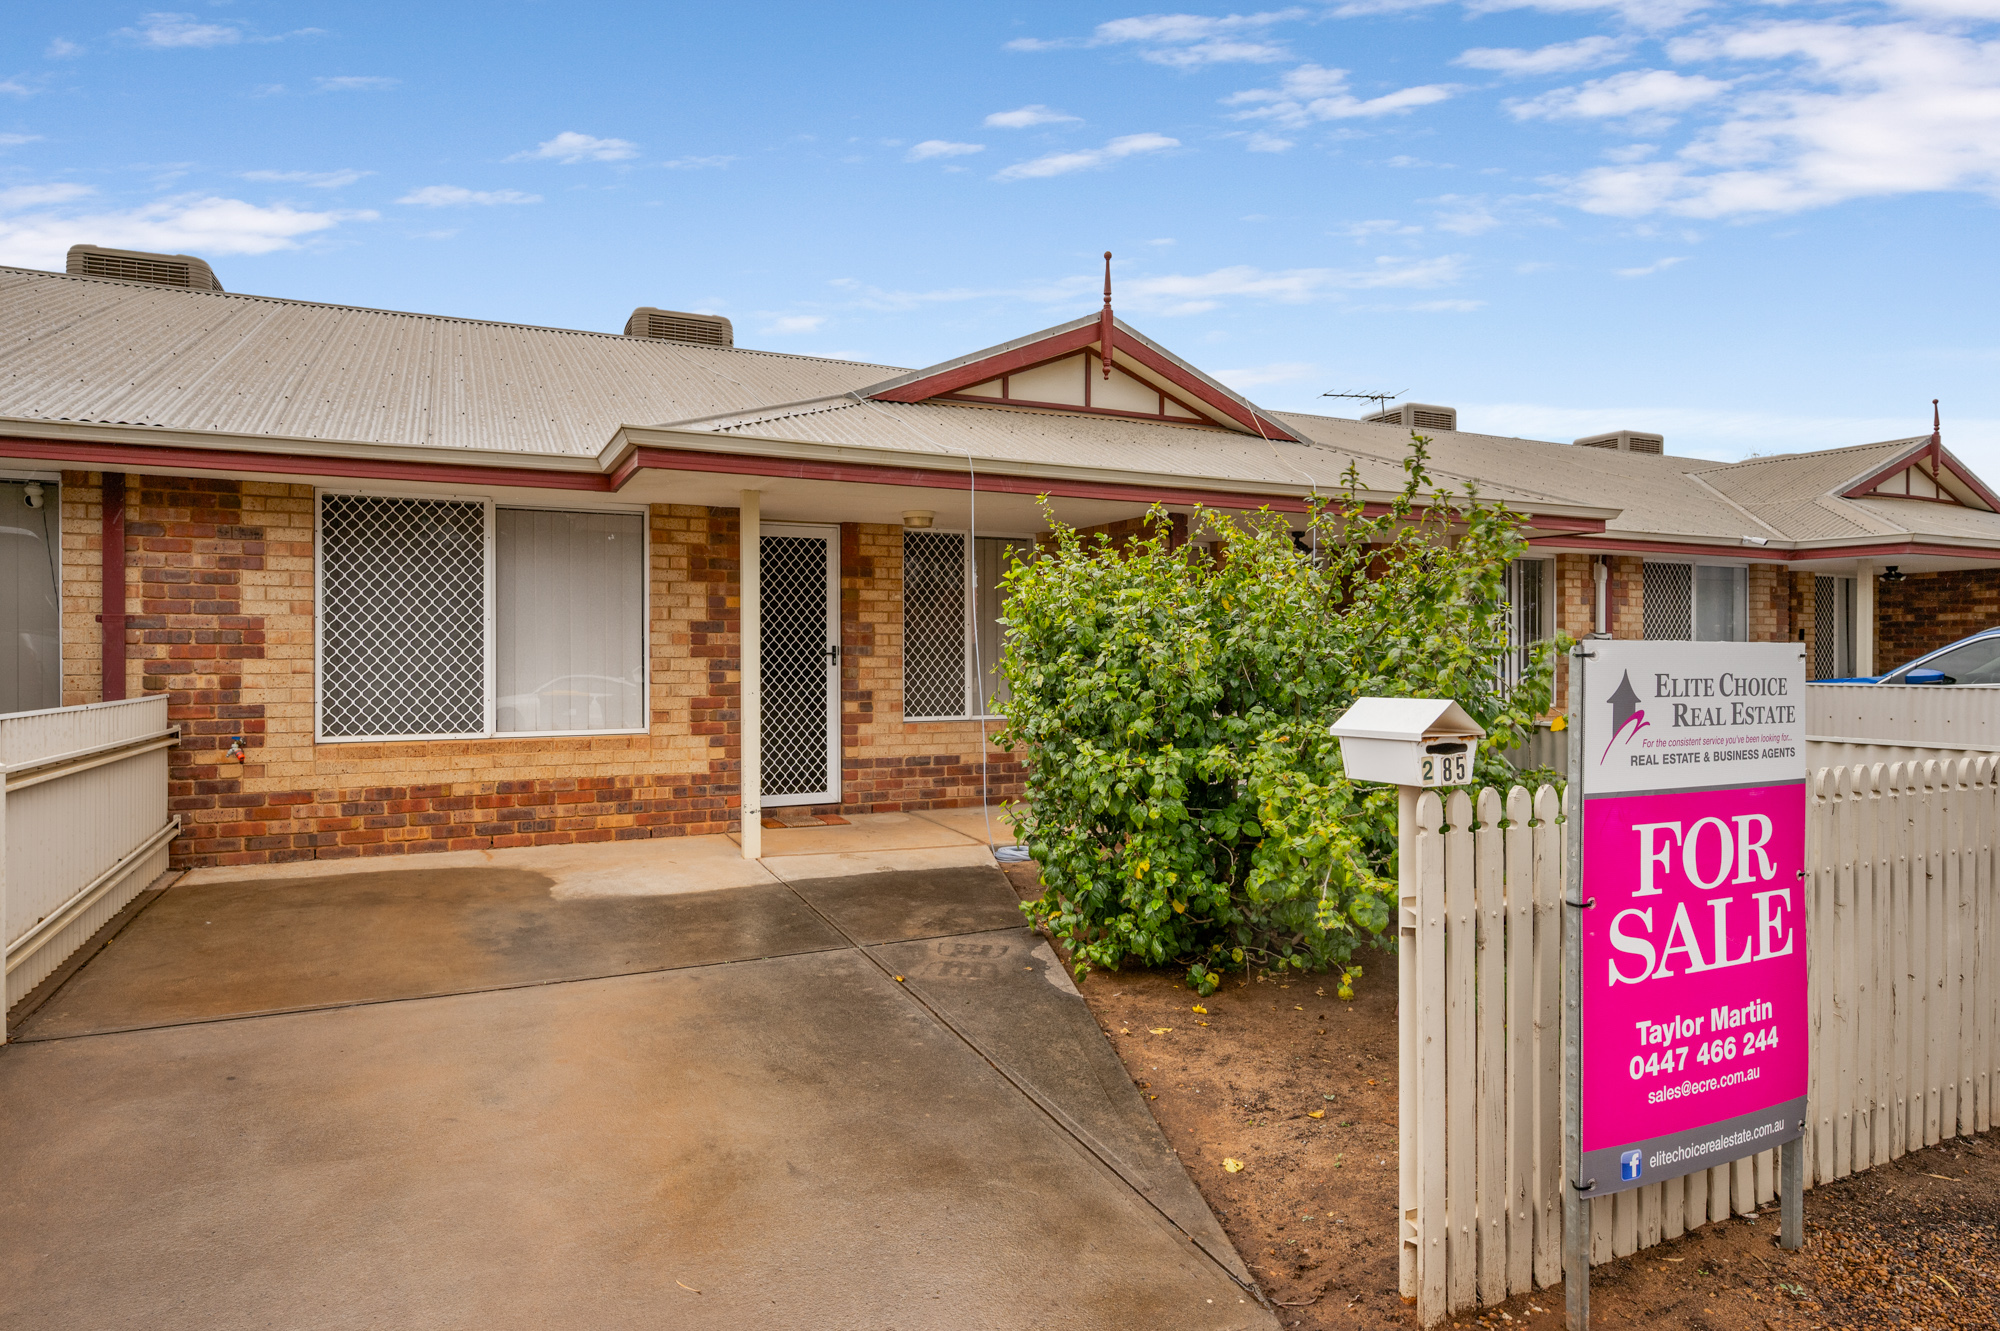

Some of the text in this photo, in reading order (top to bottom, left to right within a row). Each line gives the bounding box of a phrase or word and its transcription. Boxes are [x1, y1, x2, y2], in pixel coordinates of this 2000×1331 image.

[1654, 672, 1788, 698] ELITE CHOICE
[1672, 702, 1796, 727] REAL ESTATE
[1630, 748, 1796, 766] REAL ESTATE & BUSINESS AGENTS
[1642, 738, 1653, 748] For
[1656, 737, 1666, 748] the
[1668, 736, 1701, 747] consistent
[1702, 735, 1724, 746] service
[1725, 734, 1745, 747] you've
[1746, 734, 1760, 745] been
[1760, 734, 1780, 746] looking
[1632, 814, 1777, 897] FOR
[1608, 888, 1793, 987] SALE
[1636, 998, 1773, 1047] Taylor Martin
[1630, 1026, 1779, 1080] 0447 466 244
[1648, 1066, 1760, 1104] sales@ecre.com.au
[1650, 1118, 1784, 1168] elitechoicerealestate.com.au
[1630, 1153, 1640, 1178] f
